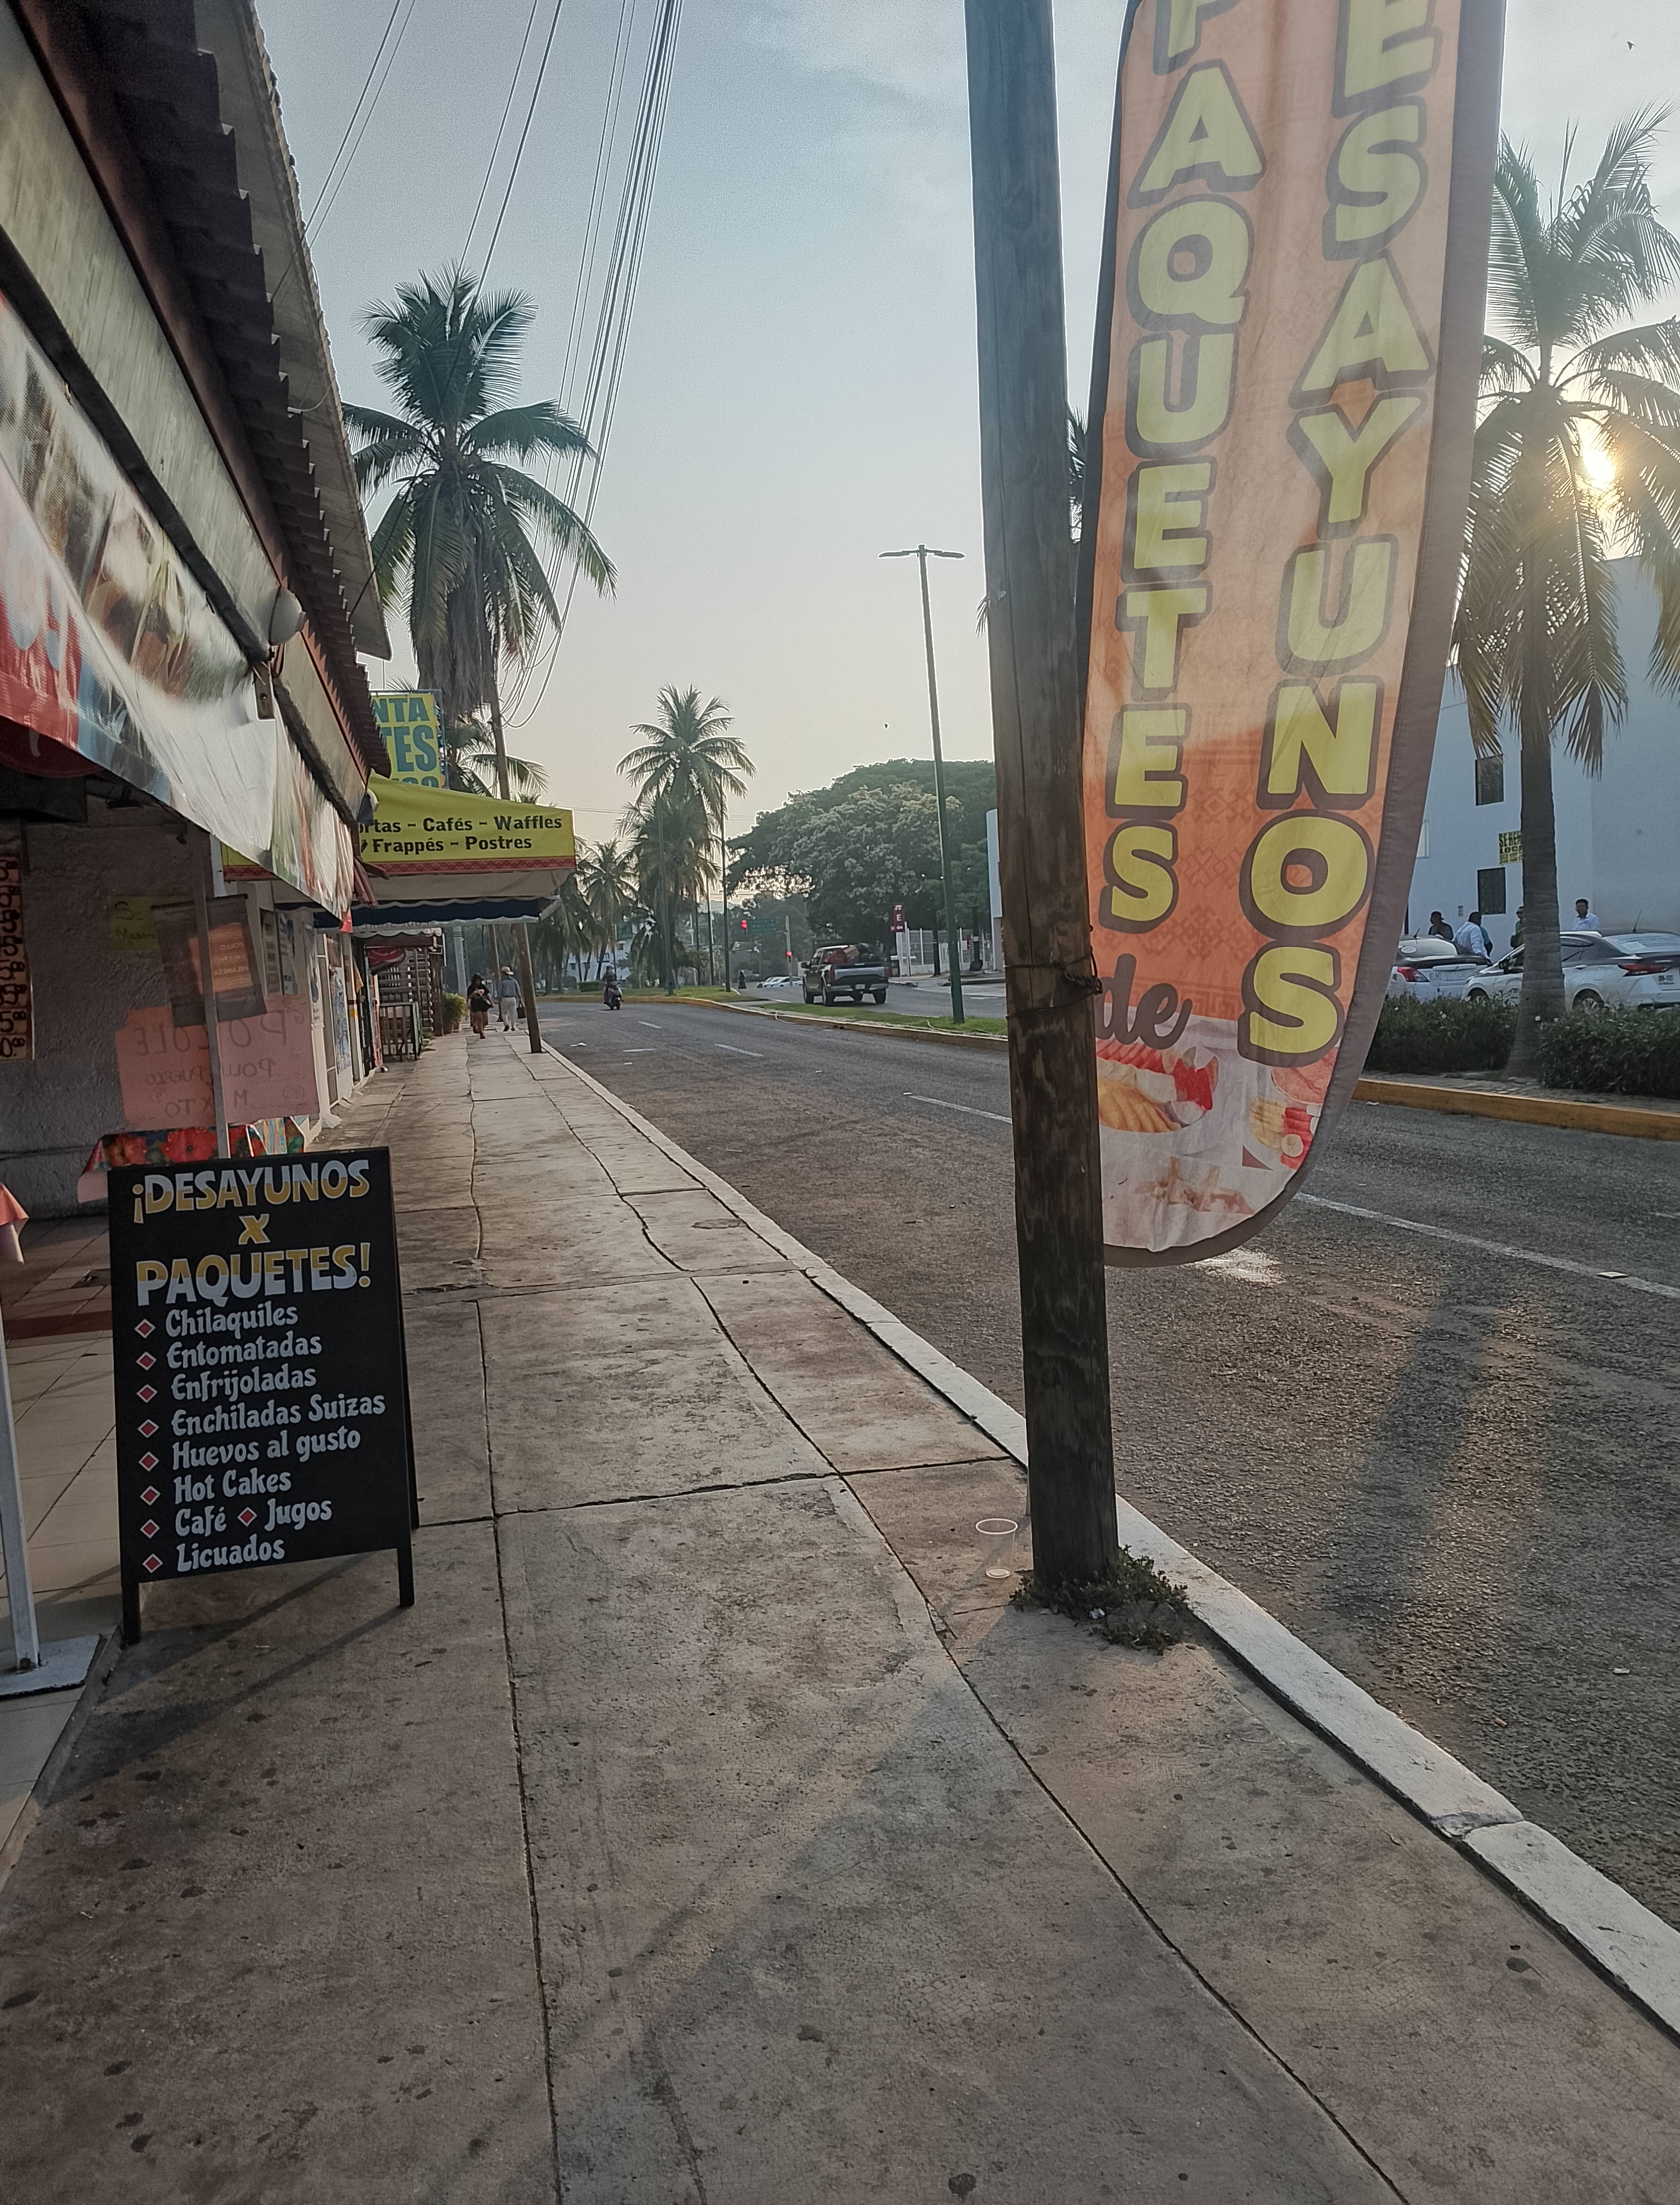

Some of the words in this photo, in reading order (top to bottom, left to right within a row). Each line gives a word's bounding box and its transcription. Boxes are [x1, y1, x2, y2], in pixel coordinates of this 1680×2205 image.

[423, 817, 472, 832] Cafés
[494, 815, 562, 831] Waffles
[372, 837, 444, 855] Frappés
[465, 836, 532, 850] Postres
[132, 1160, 369, 1224] ¡DESAYUNOS
[136, 1242, 371, 1306] PAQUETES!
[166, 1302, 298, 1339] Chilaquiles
[167, 1331, 322, 1368] Entomatadas
[171, 1363, 317, 1402] Enfrijoladas
[171, 1399, 301, 1437] Enchiladas
[308, 1393, 386, 1422] Suizas
[172, 1440, 259, 1470] Huevos
[267, 1430, 289, 1459] al
[296, 1425, 361, 1462] gusto
[173, 1474, 215, 1504] Hot
[223, 1468, 291, 1497] Cakes
[175, 1505, 227, 1537] Café
[264, 1498, 332, 1531] Jugos
[176, 1533, 285, 1572] Licuados
